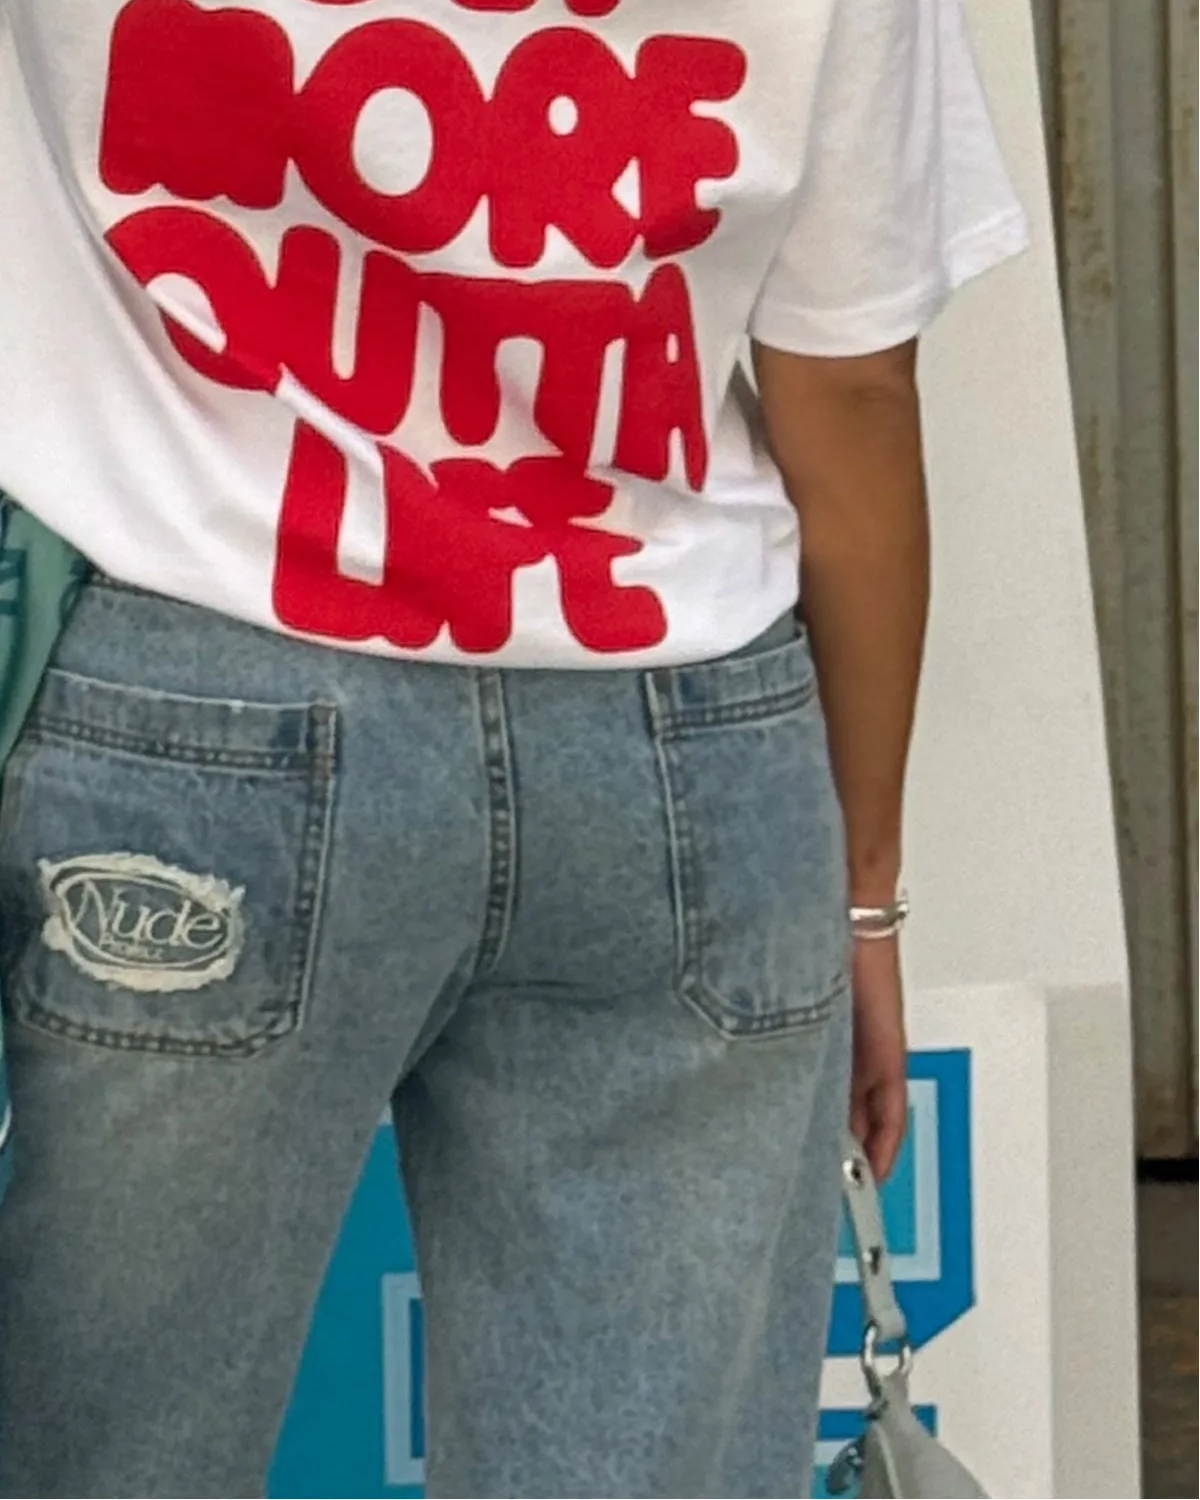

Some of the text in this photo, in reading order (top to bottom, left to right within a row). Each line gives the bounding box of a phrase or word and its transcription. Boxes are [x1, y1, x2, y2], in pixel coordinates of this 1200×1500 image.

[103, 205, 708, 492] OUTTA
[273, 418, 667, 653] LIFE
[72, 879, 225, 951] Nude
